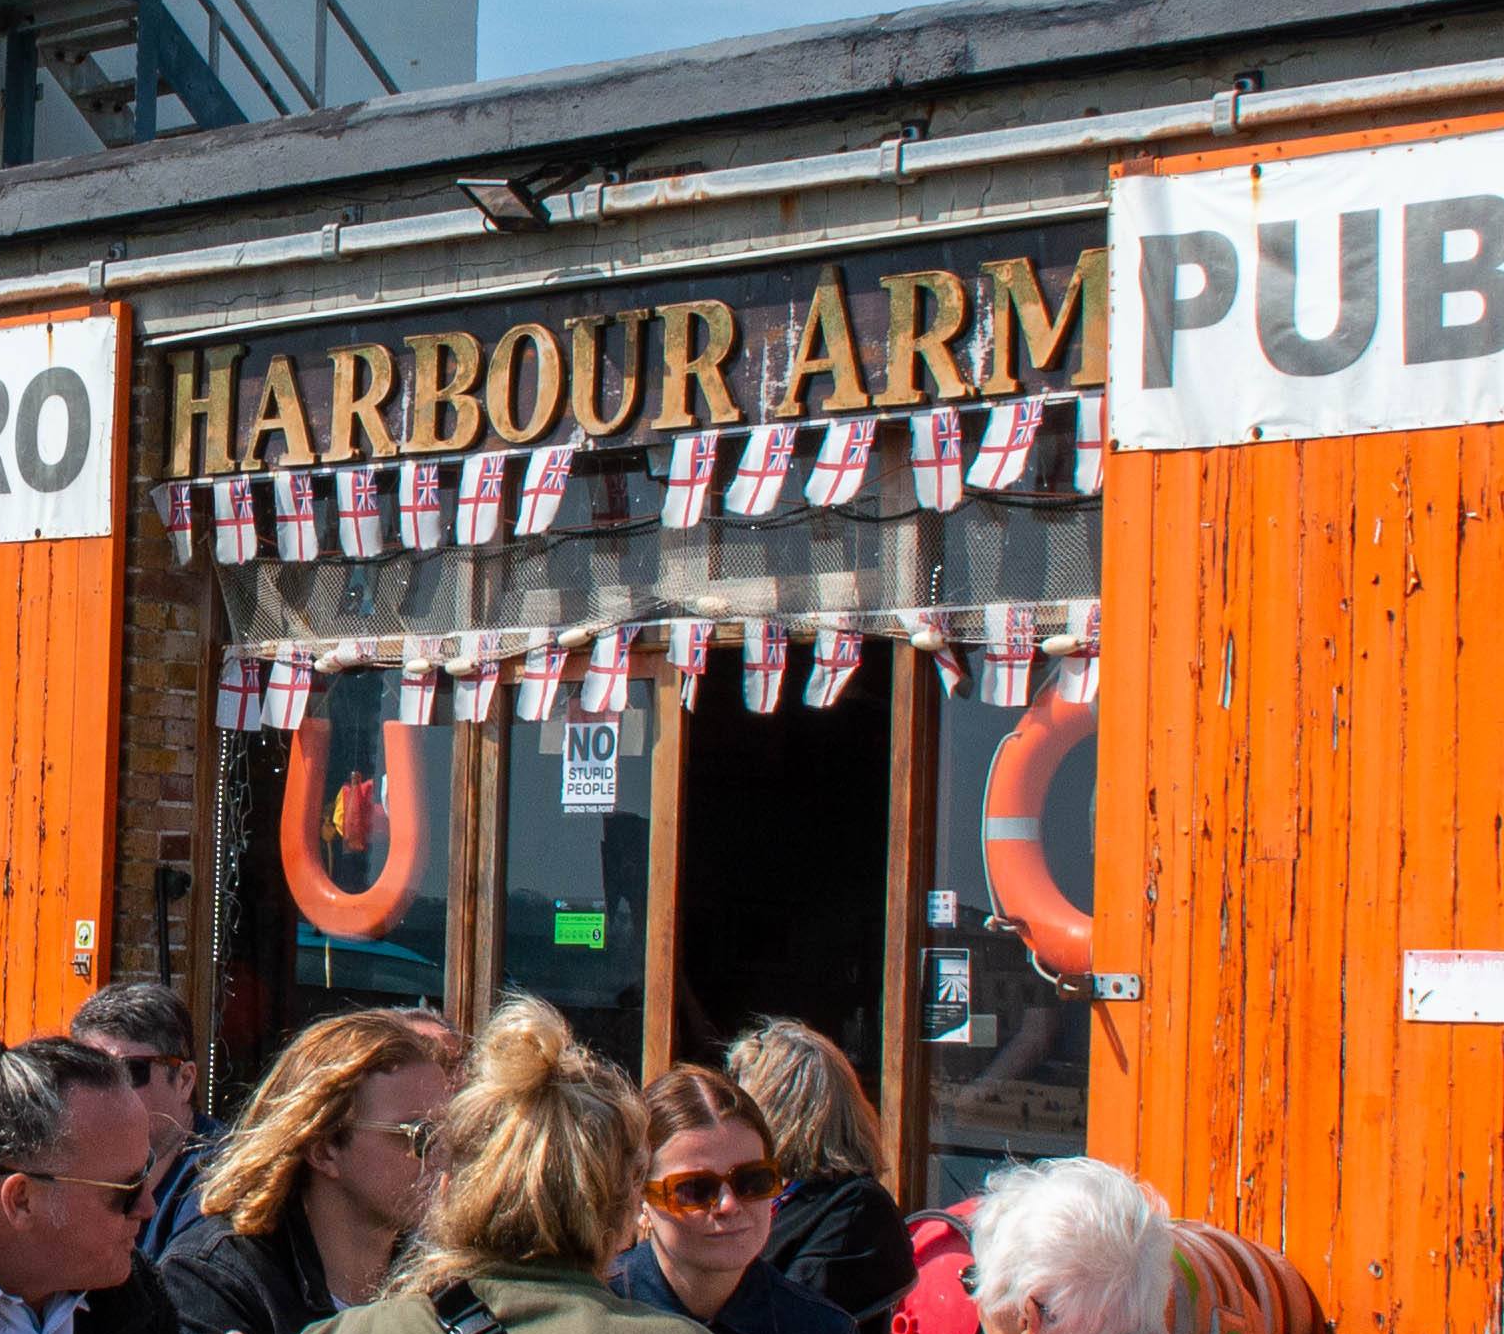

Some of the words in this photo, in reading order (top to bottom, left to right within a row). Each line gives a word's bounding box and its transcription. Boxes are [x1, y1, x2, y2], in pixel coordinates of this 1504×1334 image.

[165, 298, 743, 478] HARBOUR
[568, 725, 615, 762] NO
[568, 767, 614, 780] STUPID
[567, 783, 615, 795] PEOPLE
